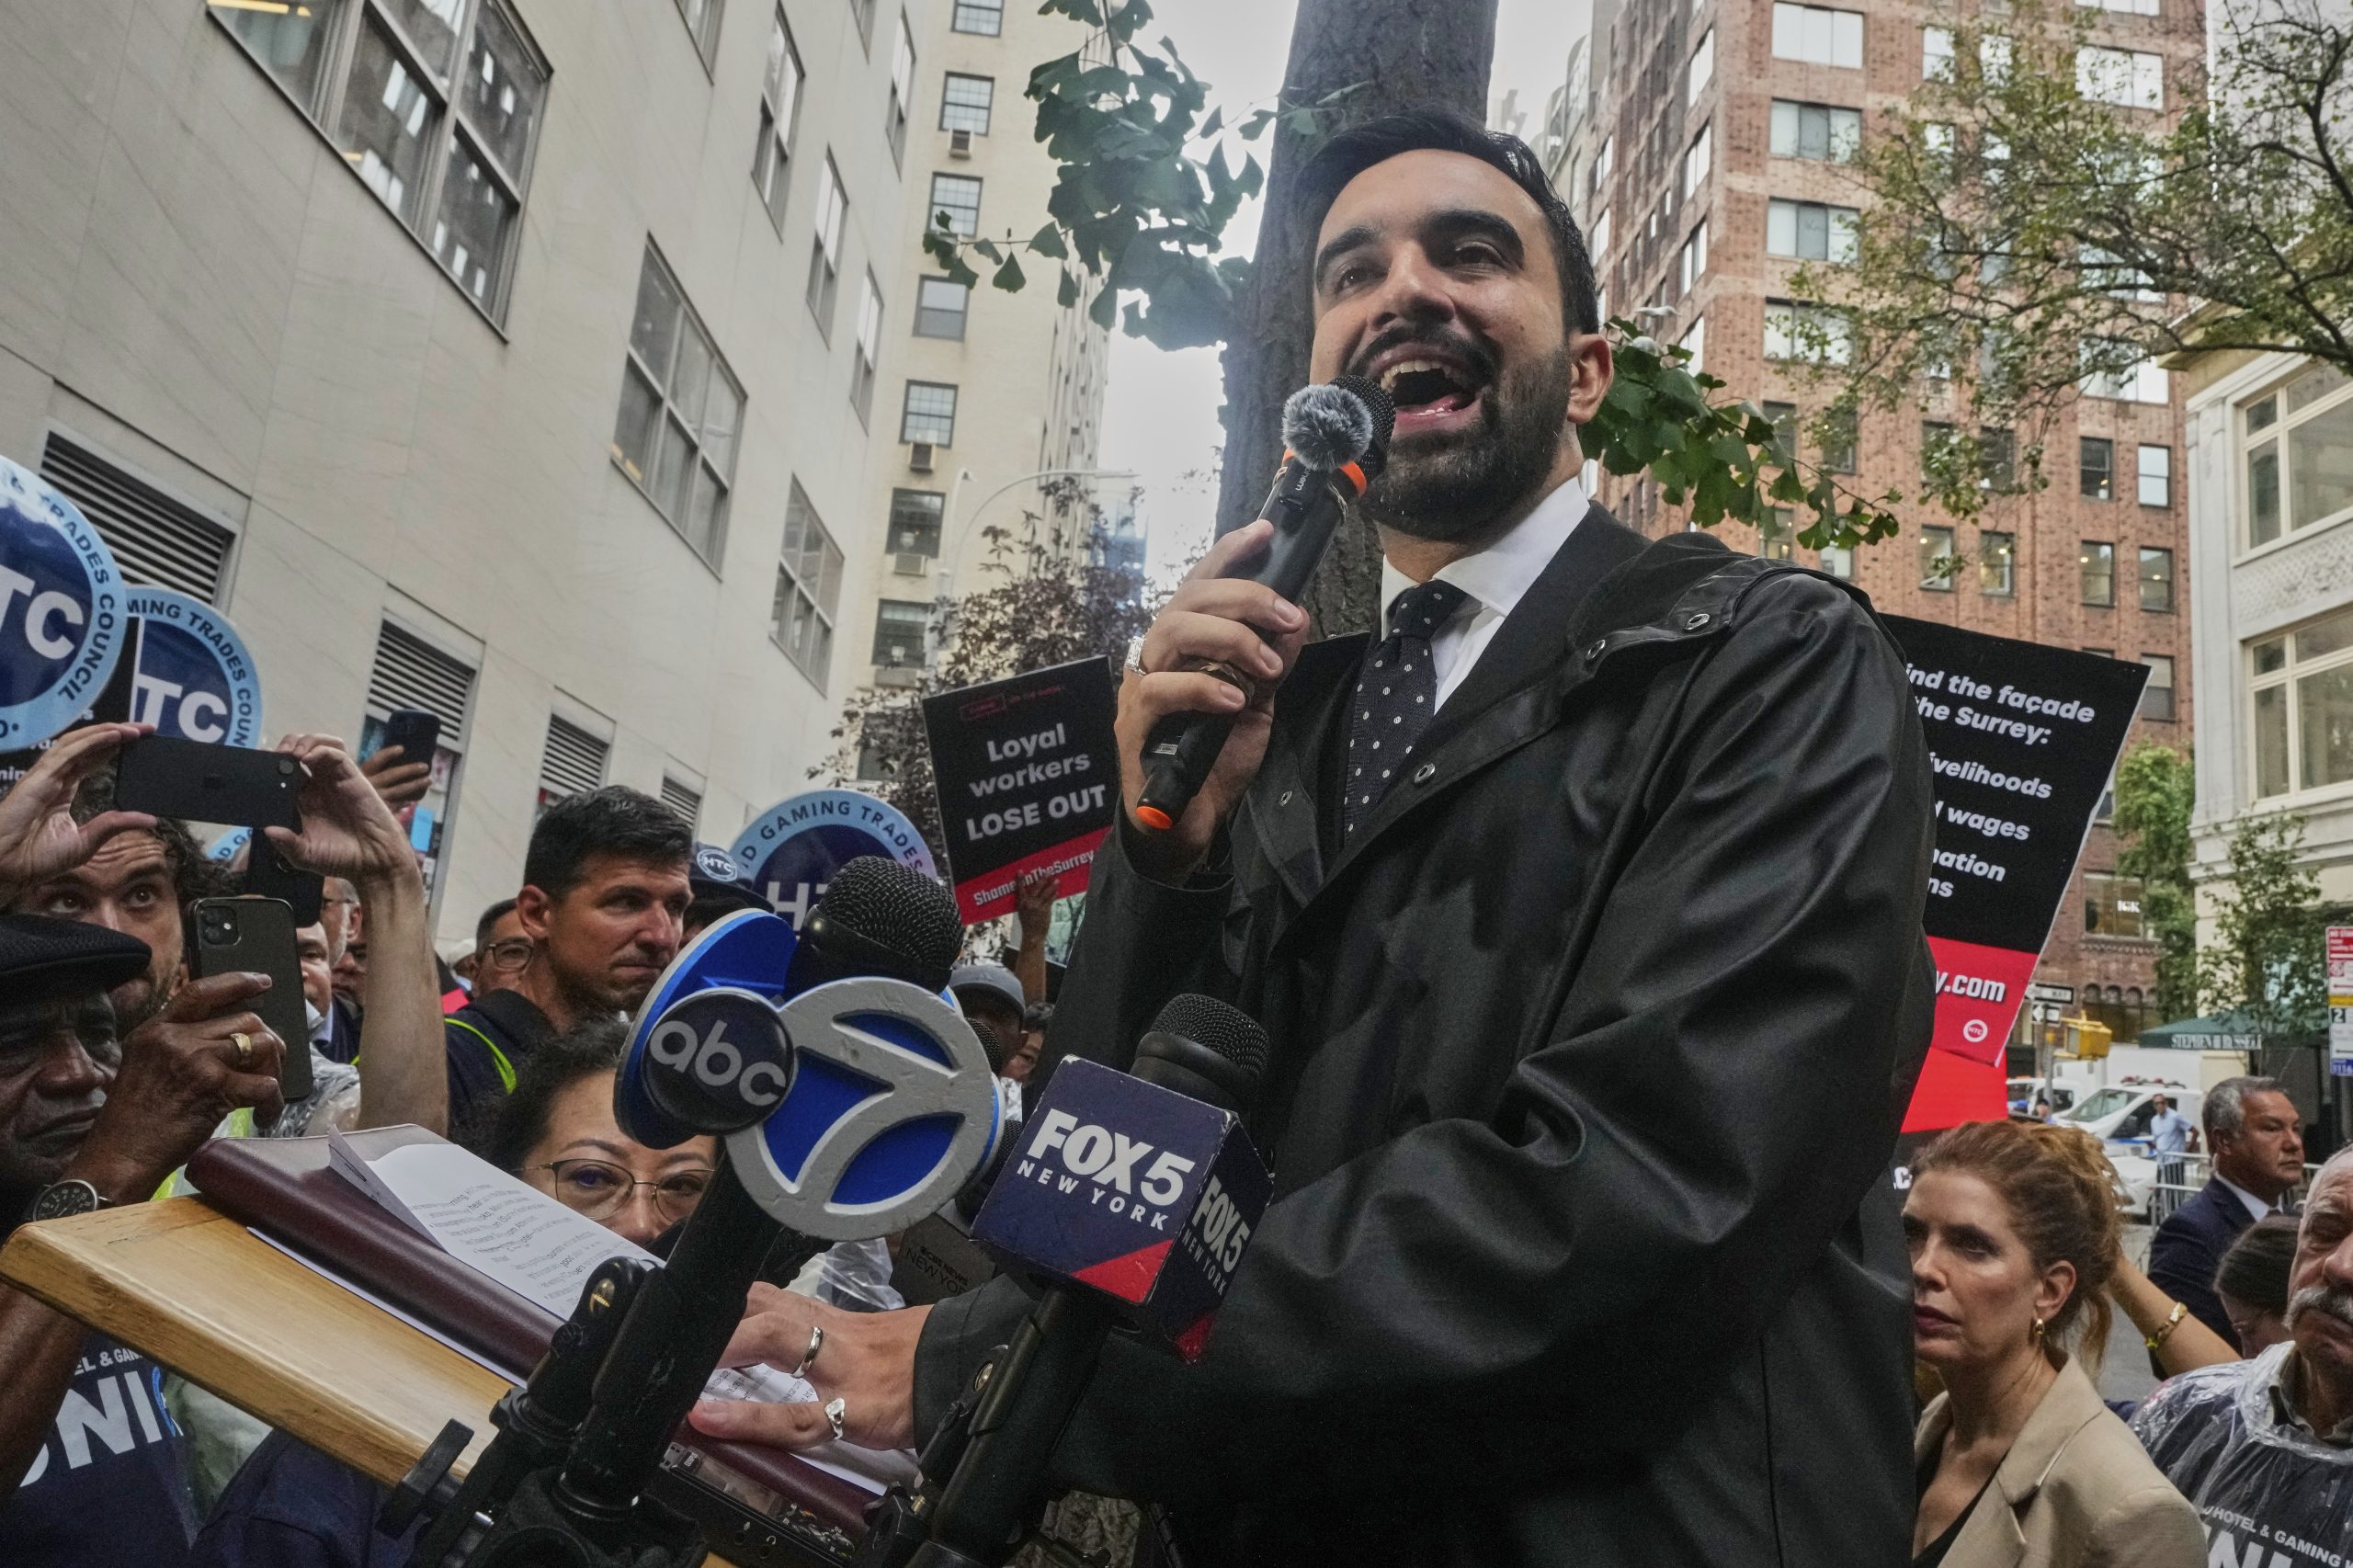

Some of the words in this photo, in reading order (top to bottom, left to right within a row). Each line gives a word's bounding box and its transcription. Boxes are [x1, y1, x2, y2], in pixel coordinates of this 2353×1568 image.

[57, 594, 115, 700] COUNCIL
[189, 612, 246, 682] TRADES
[135, 673, 227, 744] TC
[1949, 676, 1992, 699] the
[1997, 685, 2096, 723] façade
[1955, 707, 2052, 745] Surrey:
[986, 722, 1066, 763] Loyal
[969, 753, 1091, 797] workers
[741, 844, 757, 869] D
[760, 801, 850, 840] GAMING
[860, 806, 923, 870] TRADES
[966, 802, 1041, 841] LOSE
[1048, 785, 1106, 820] OUT
[1948, 807, 2030, 840] wages
[702, 855, 733, 873] HTC
[973, 849, 1094, 906] ShamenTheSurrey
[767, 881, 827, 932] H
[2335, 1008, 2343, 1022] 2
[649, 1019, 787, 1107] abc
[1017, 1160, 1080, 1195] NEW
[1091, 1188, 1169, 1232] YORK
[1182, 1228, 1204, 1263] NEW
[1202, 1256, 1227, 1296] YORK
[99, 1351, 113, 1367] &
[2211, 1506, 2256, 1534] HOTEL
[2260, 1524, 2269, 1538] &
[2274, 1529, 2342, 1568] GAMING
